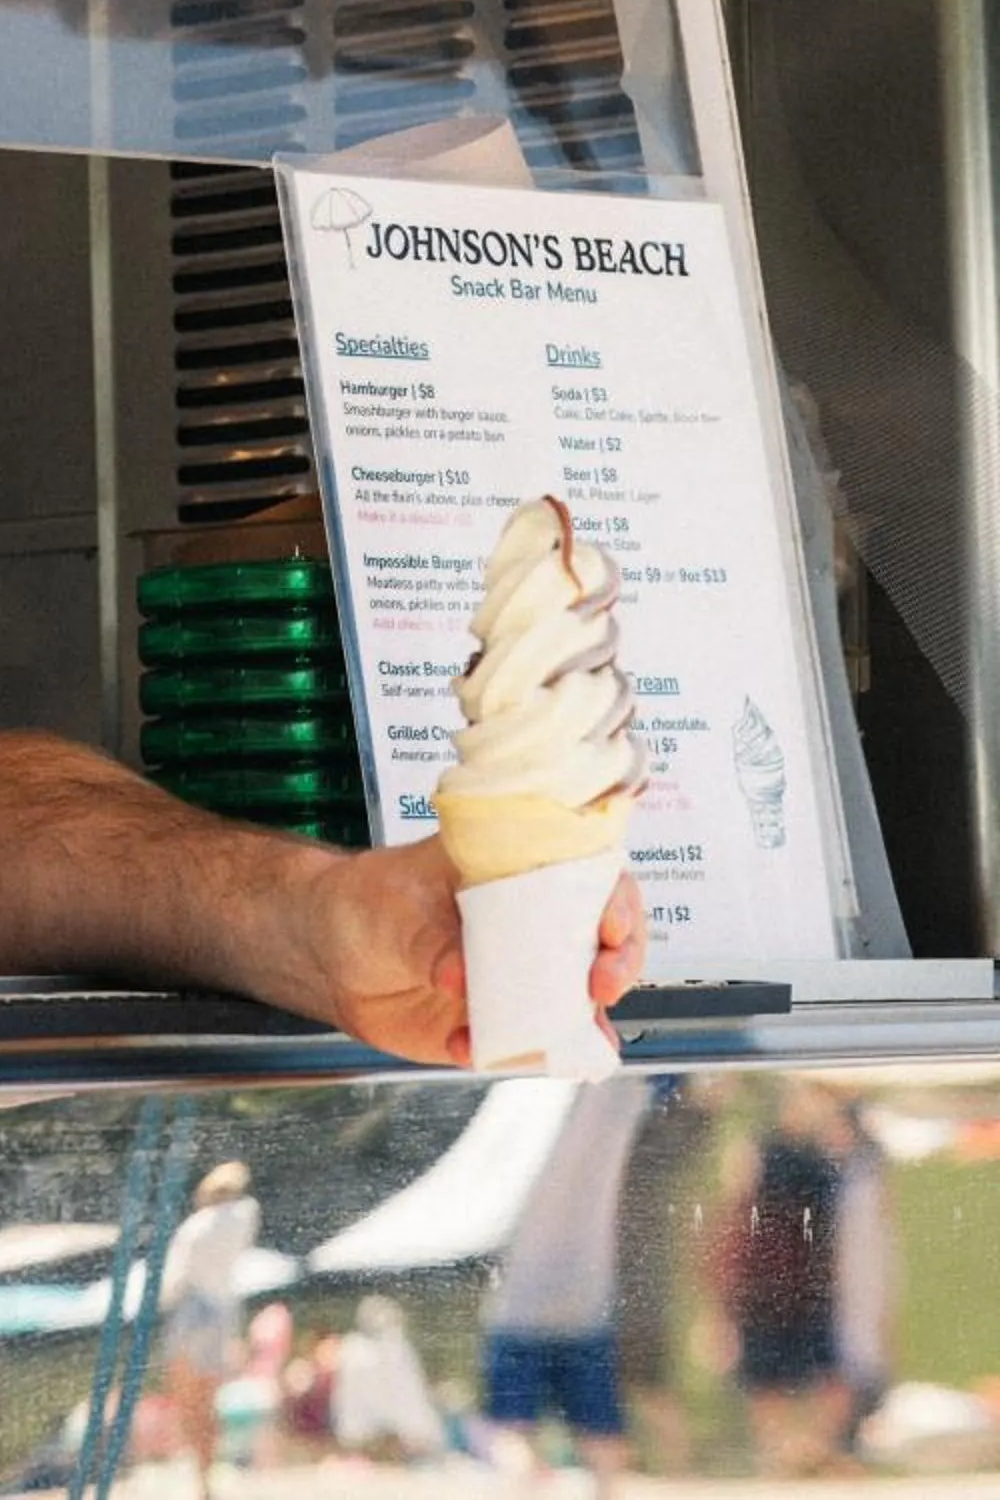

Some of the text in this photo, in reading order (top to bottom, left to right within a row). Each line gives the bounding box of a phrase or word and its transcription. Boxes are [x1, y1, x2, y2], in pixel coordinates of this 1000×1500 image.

[366, 222, 690, 277] JOHNSON'S BEACH
[450, 274, 598, 304] Snack Bar Menu
[335, 331, 430, 358] Specialties
[545, 344, 602, 367] Drinks
[339, 379, 409, 400] Hamburger
[418, 383, 436, 400] $8
[551, 386, 583, 401] Soda
[591, 387, 608, 402] $3
[343, 402, 412, 420] Smashburger
[415, 405, 439, 419] with
[441, 408, 475, 423] burger
[384, 425, 420, 440] pickles
[424, 430, 438, 440] on
[447, 429, 482, 442] potato
[558, 435, 596, 451] Water
[606, 437, 623, 452] $2
[351, 466, 436, 487] Cheeseburger
[446, 468, 471, 486] $10
[563, 466, 592, 481] Beer
[601, 467, 618, 483] $8
[355, 489, 371, 501] All
[373, 489, 390, 502] the
[461, 493, 483, 507] plus
[571, 516, 603, 531] Cider
[363, 553, 430, 571] Impossible
[431, 555, 474, 573] Burger
[646, 567, 661, 583] $9
[679, 567, 701, 583] 9oz
[702, 567, 728, 584] $13
[366, 576, 414, 591] Meatless
[415, 578, 444, 594] patty
[446, 579, 470, 591] with
[408, 599, 445, 613] pickles
[448, 601, 462, 612] on
[378, 660, 421, 677] Classic
[423, 661, 461, 677] Beach
[381, 683, 435, 698] Self-serve
[387, 725, 429, 741] Grilled
[661, 737, 678, 753] $5
[391, 748, 441, 762] American
[630, 847, 679, 862] opsicles
[687, 844, 703, 861] $2
[674, 905, 691, 921] $2
